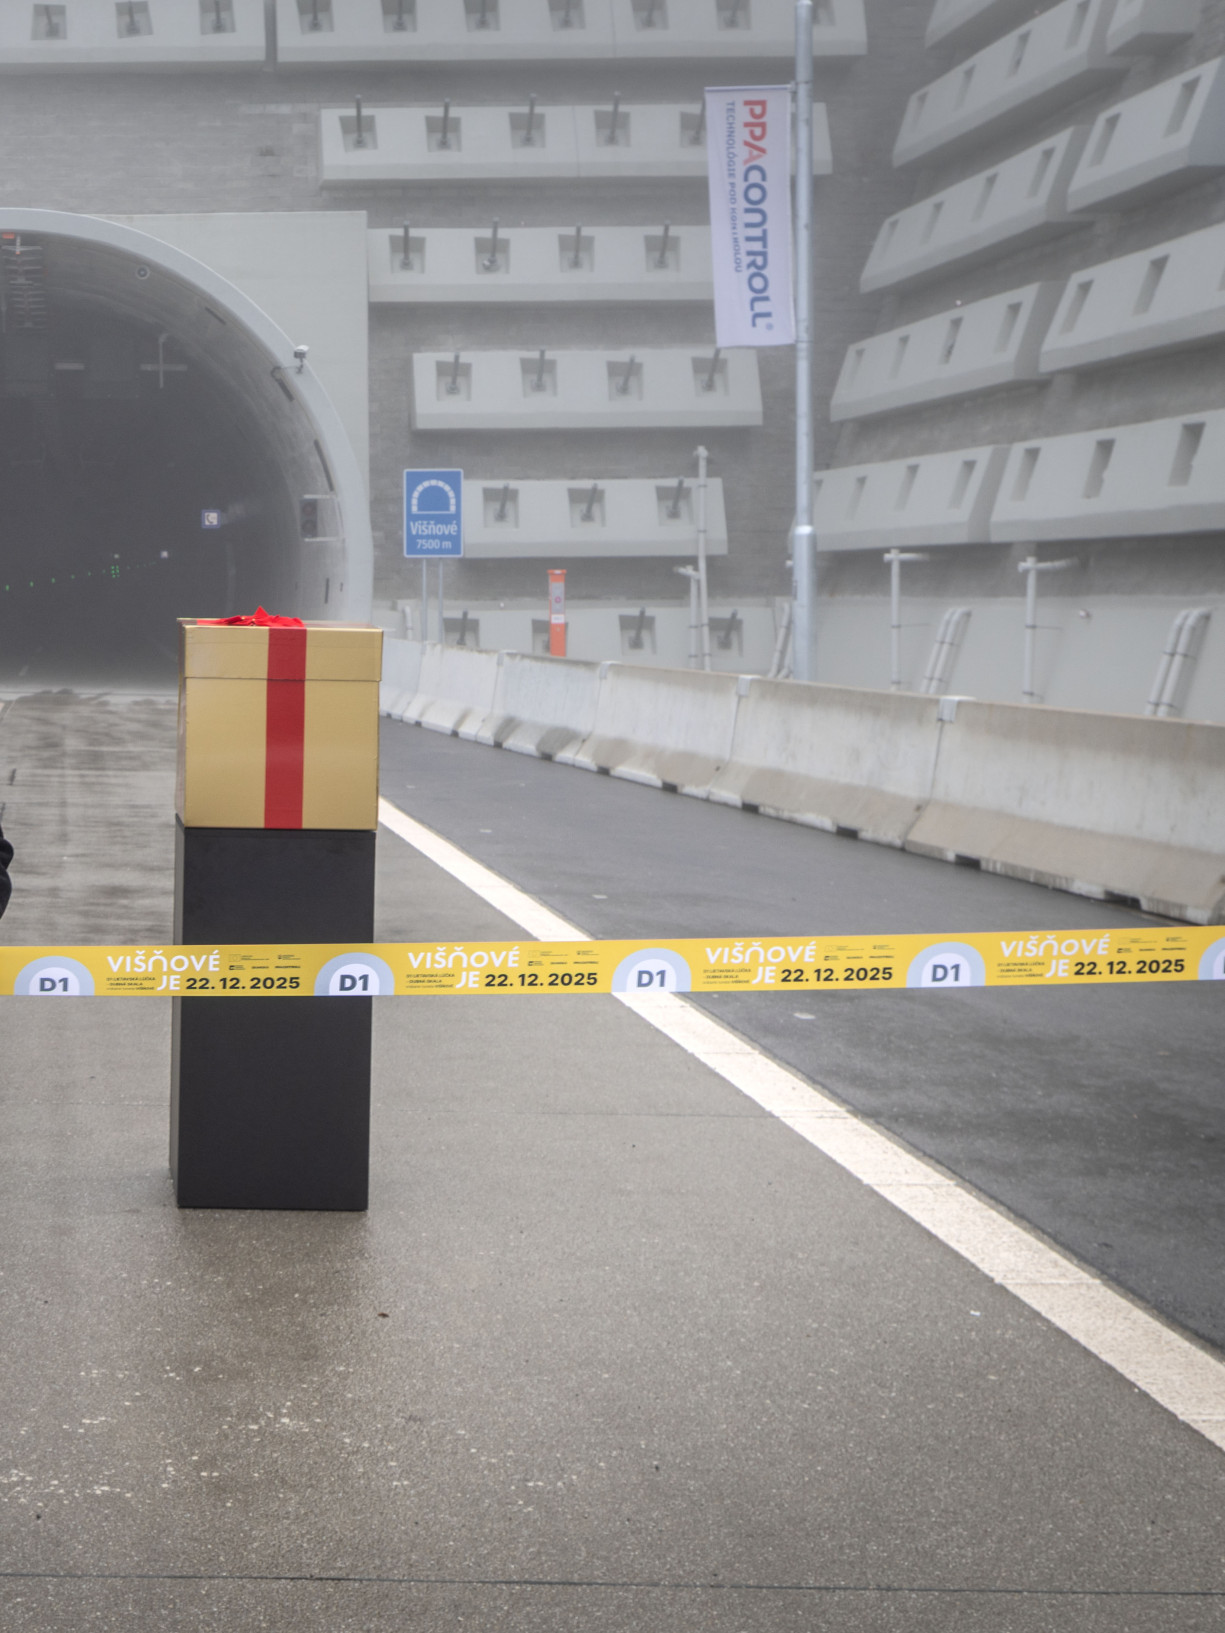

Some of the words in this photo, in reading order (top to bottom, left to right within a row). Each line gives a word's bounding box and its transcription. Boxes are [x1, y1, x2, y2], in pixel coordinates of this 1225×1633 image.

[728, 181, 737, 205] POD
[410, 520, 458, 535] Višňové
[416, 539, 440, 549] 7500
[442, 541, 452, 549] m
[705, 941, 817, 964] VIŠŇOVÉ
[1000, 934, 1111, 957] VIŠŇOVÉ
[107, 950, 220, 973] VIŠŇOVÉ
[408, 946, 520, 969] VIŠŇOVÉ
[752, 966, 776, 984] JE
[931, 964, 961, 982] D1
[1045, 959, 1069, 978] JE
[39, 977, 69, 992] D1
[157, 975, 181, 991] JE
[339, 974, 369, 991] D1
[456, 971, 480, 988] JE
[637, 969, 666, 988] D1
